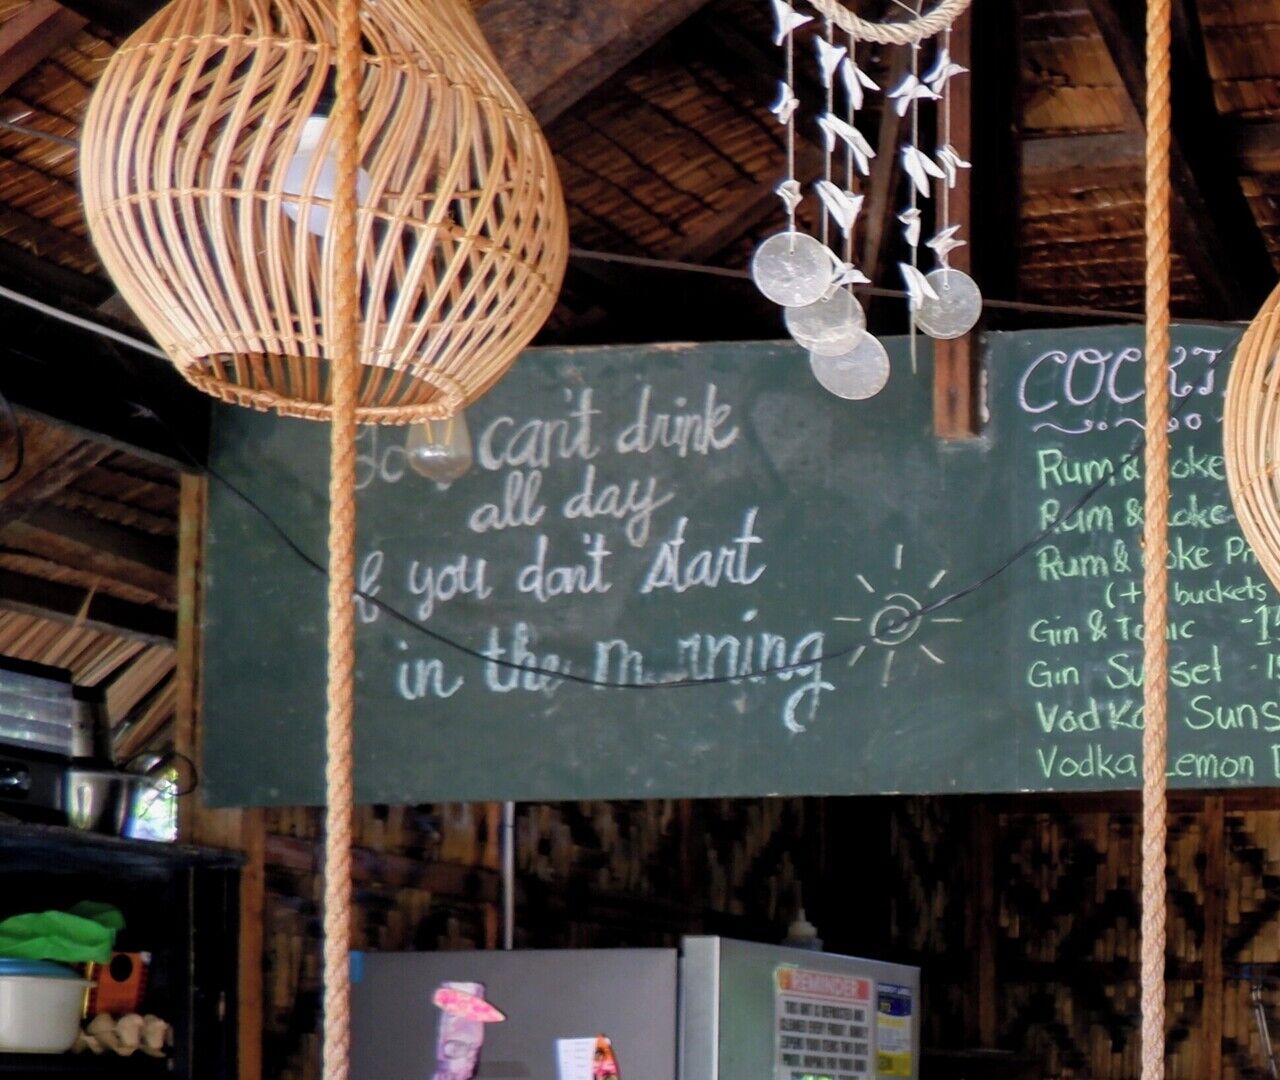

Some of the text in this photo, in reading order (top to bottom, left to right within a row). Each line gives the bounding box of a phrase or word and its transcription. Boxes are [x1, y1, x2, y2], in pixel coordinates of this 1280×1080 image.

[479, 387, 600, 471] can't
[616, 384, 740, 456] drink
[1037, 449, 1112, 489] Rum
[1168, 445, 1225, 481] oke
[470, 466, 676, 548] all day
[1041, 498, 1112, 534] Rum
[1168, 492, 1229, 528] oke
[408, 556, 493, 620] you
[519, 534, 611, 596] don't
[642, 508, 767, 596] start
[1037, 547, 1108, 583] Rum
[1142, 536, 1214, 572] oke
[1174, 580, 1267, 606] buckets
[1030, 618, 1078, 646] Gin
[1090, 611, 1107, 642] &
[1118, 613, 1196, 642] Toic
[398, 608, 836, 734] in the mrning
[1028, 661, 1078, 688] Gin
[1106, 646, 1222, 689] Suset
[1037, 744, 1137, 779] Vodka
[1163, 752, 1254, 779] emon
